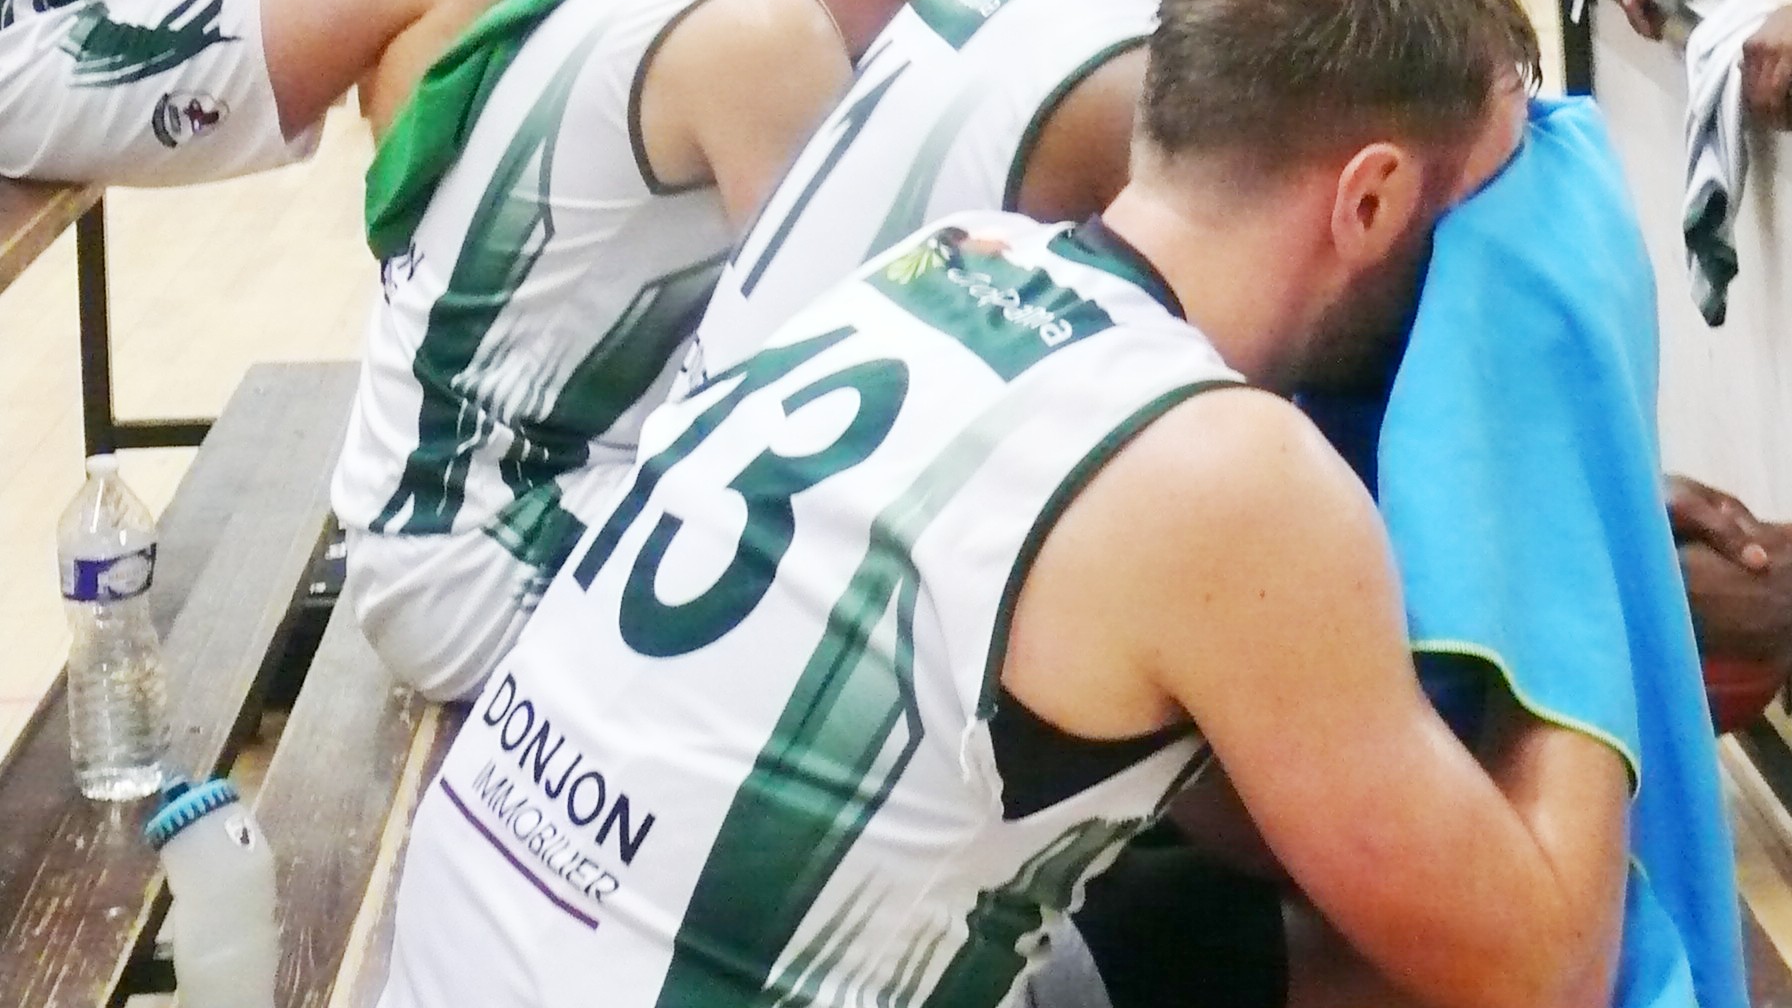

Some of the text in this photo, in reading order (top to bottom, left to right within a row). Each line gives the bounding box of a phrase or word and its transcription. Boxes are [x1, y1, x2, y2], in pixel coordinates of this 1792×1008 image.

[573, 325, 910, 659] 13
[471, 758, 620, 904] IMMOBILIER
[483, 672, 657, 867] DONJON
